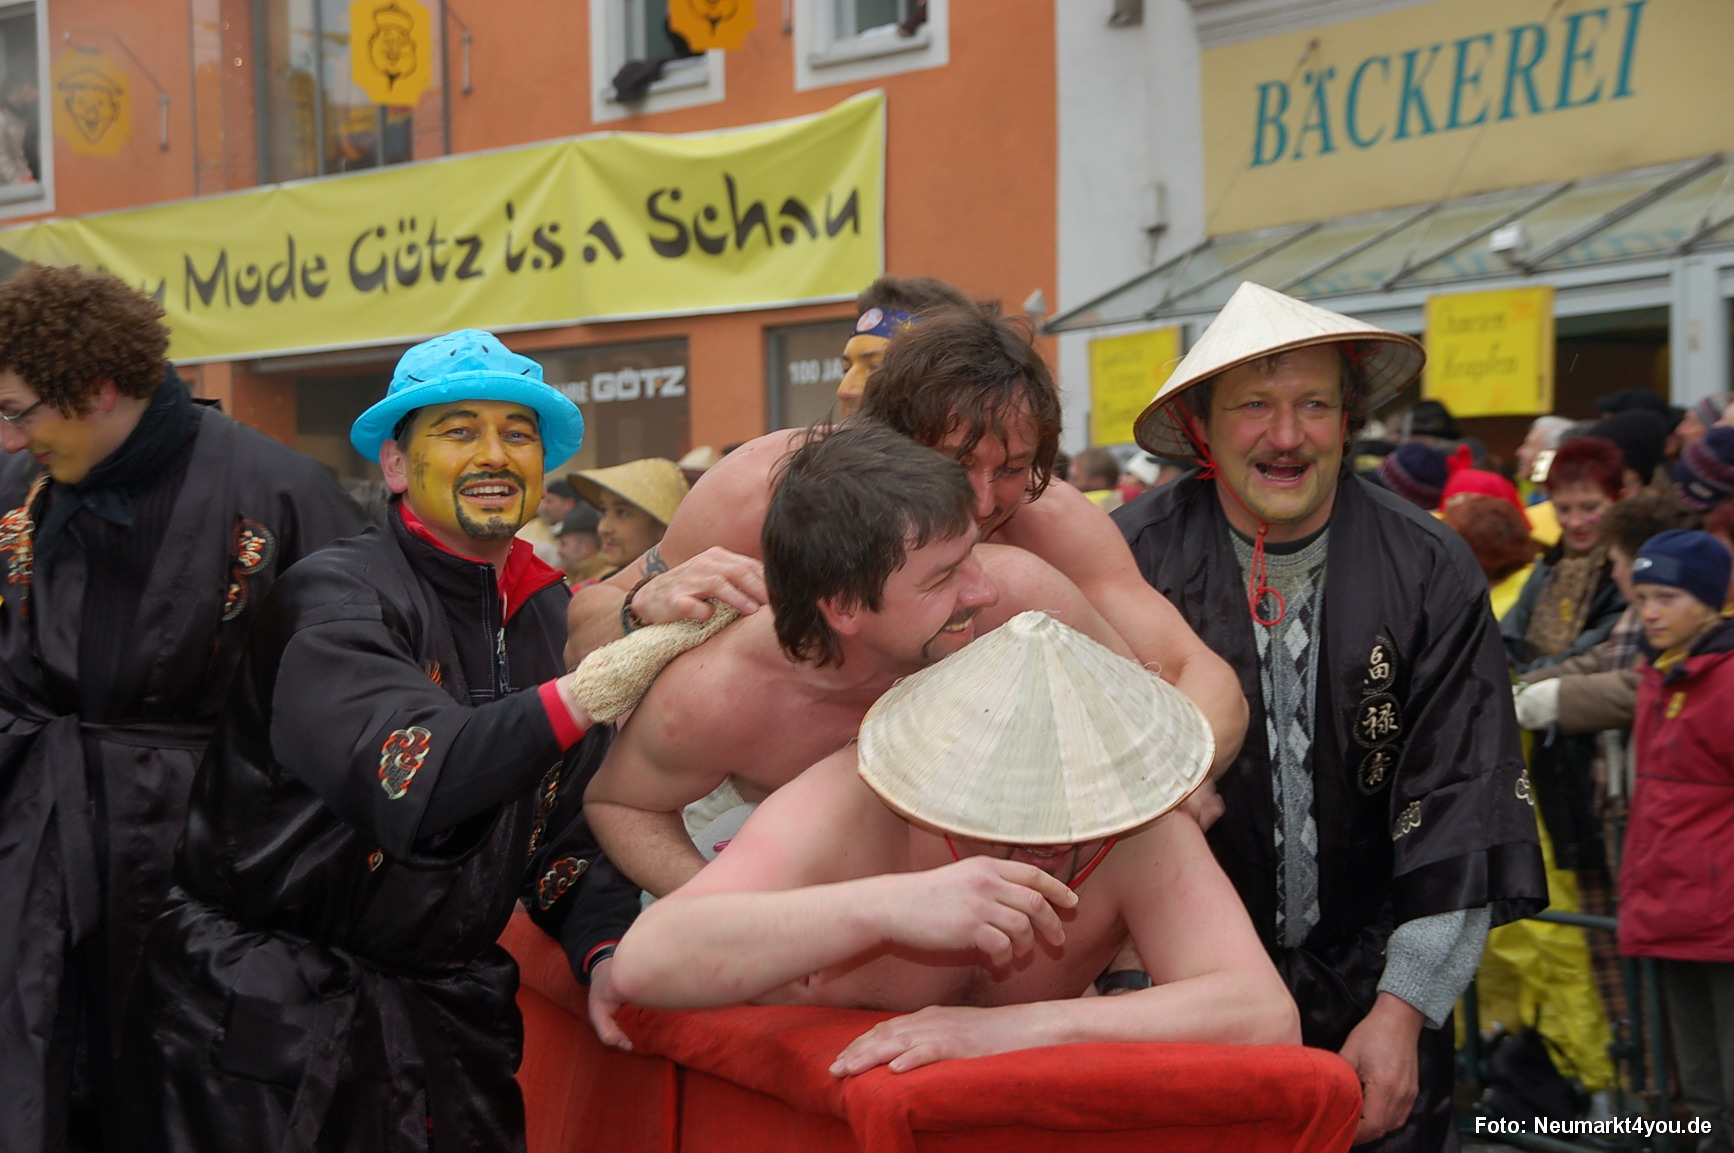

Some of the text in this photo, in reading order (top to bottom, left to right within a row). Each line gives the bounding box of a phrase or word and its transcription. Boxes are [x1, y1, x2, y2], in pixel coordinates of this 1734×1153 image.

[1249, 1, 1646, 169] BÄCKEREI
[184, 233, 329, 312] Mode
[349, 216, 486, 294] Götz
[505, 200, 565, 273] is
[646, 172, 861, 259] Schau
[592, 365, 686, 402] GÖTZ
[788, 359, 820, 386] 100
